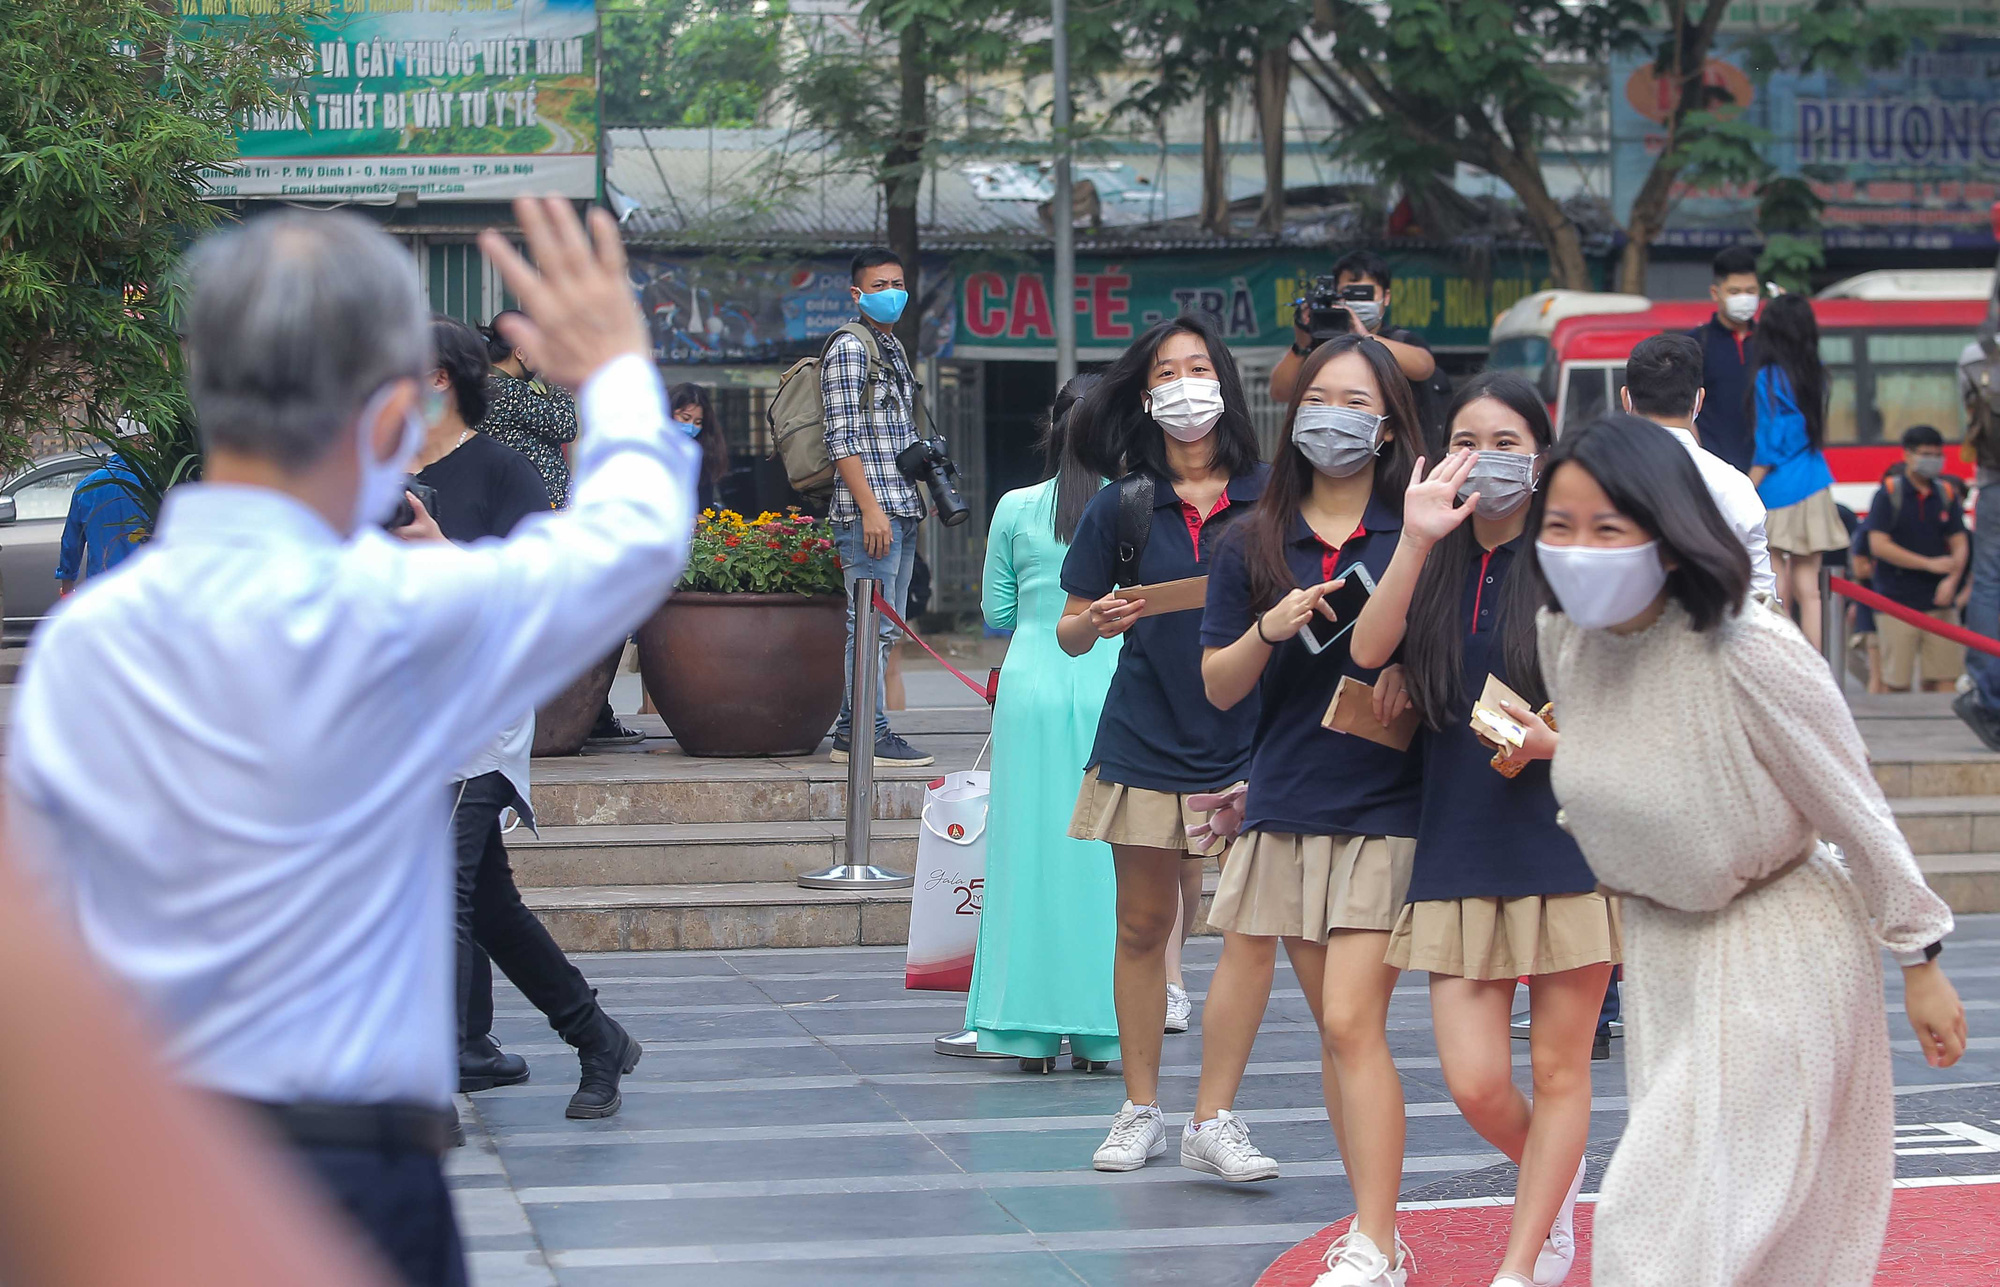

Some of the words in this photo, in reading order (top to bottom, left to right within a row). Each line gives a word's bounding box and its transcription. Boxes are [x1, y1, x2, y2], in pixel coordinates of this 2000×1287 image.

[320, 36, 350, 79] VÀ
[355, 35, 398, 78] CÂY
[403, 28, 476, 77] THUỐC
[481, 34, 530, 82] VIỆT
[535, 38, 584, 75] NAM
[315, 81, 377, 131] THIẾT
[383, 92, 407, 135] BỊ
[413, 86, 454, 135] VẬT
[459, 86, 490, 129] TƯ
[493, 91, 508, 128] Y
[512, 79, 538, 127] TẾ
[380, 165, 407, 177] Nam
